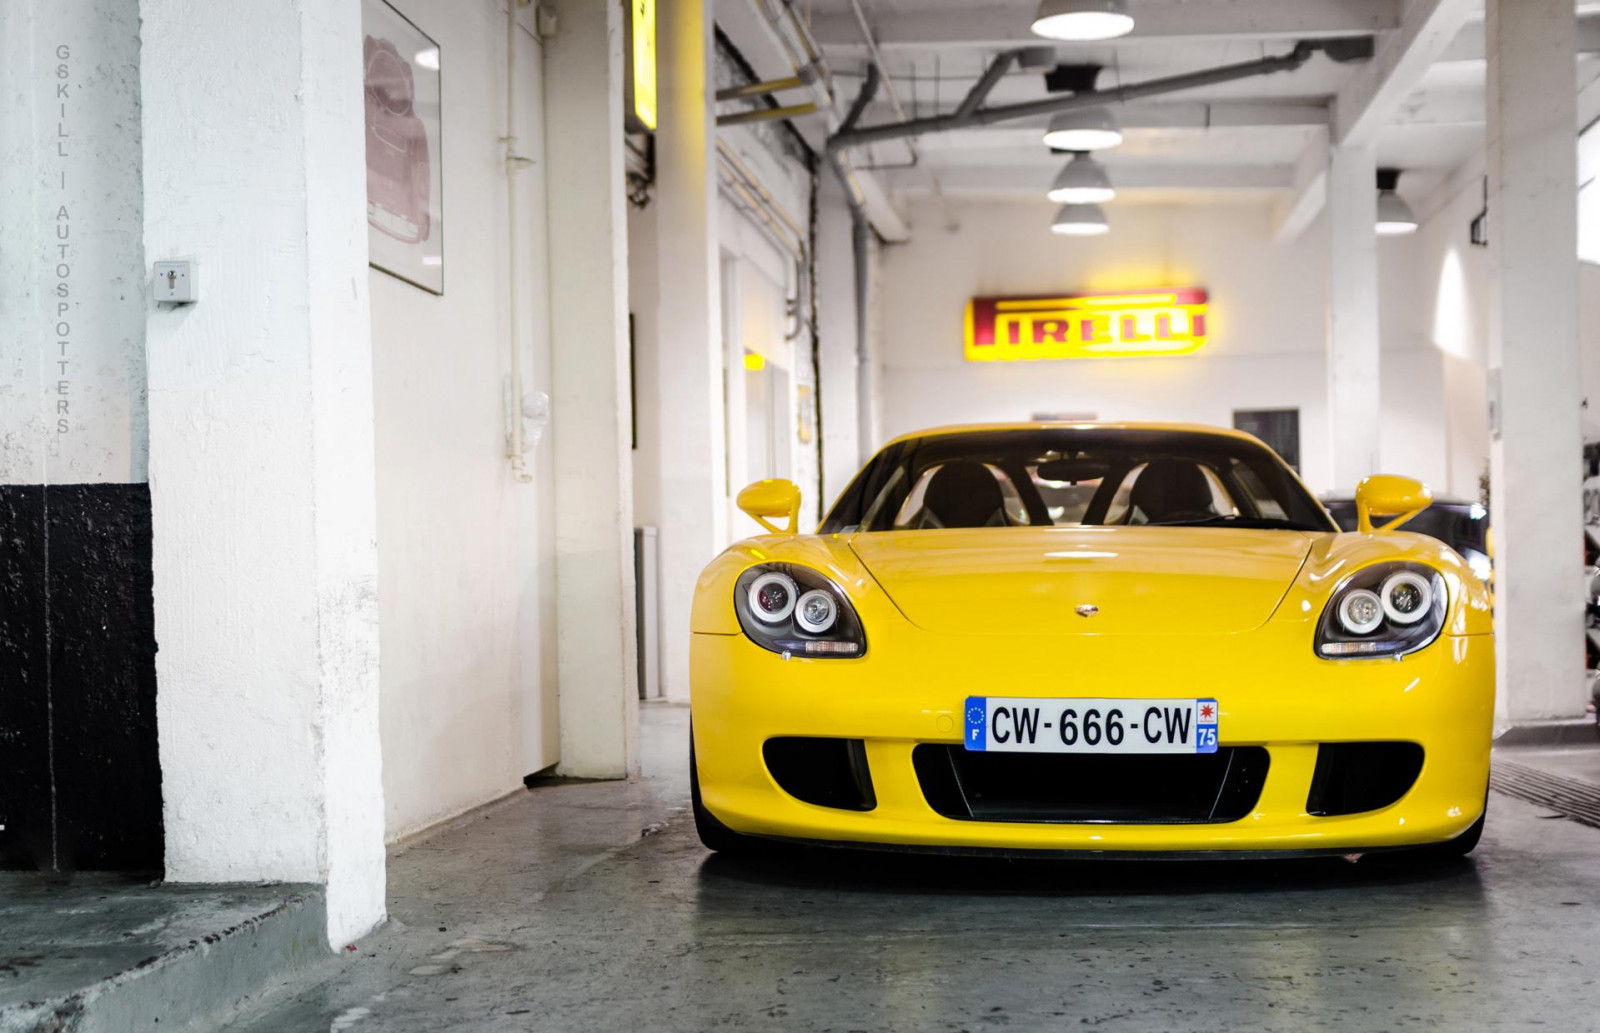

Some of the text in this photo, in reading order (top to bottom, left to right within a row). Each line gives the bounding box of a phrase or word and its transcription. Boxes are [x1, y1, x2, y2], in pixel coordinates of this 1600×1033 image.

[970, 287, 1208, 352] PIRELLI
[972, 729, 979, 740] F
[991, 706, 1192, 746] CW-666-CW
[1198, 728, 1216, 746] 75
